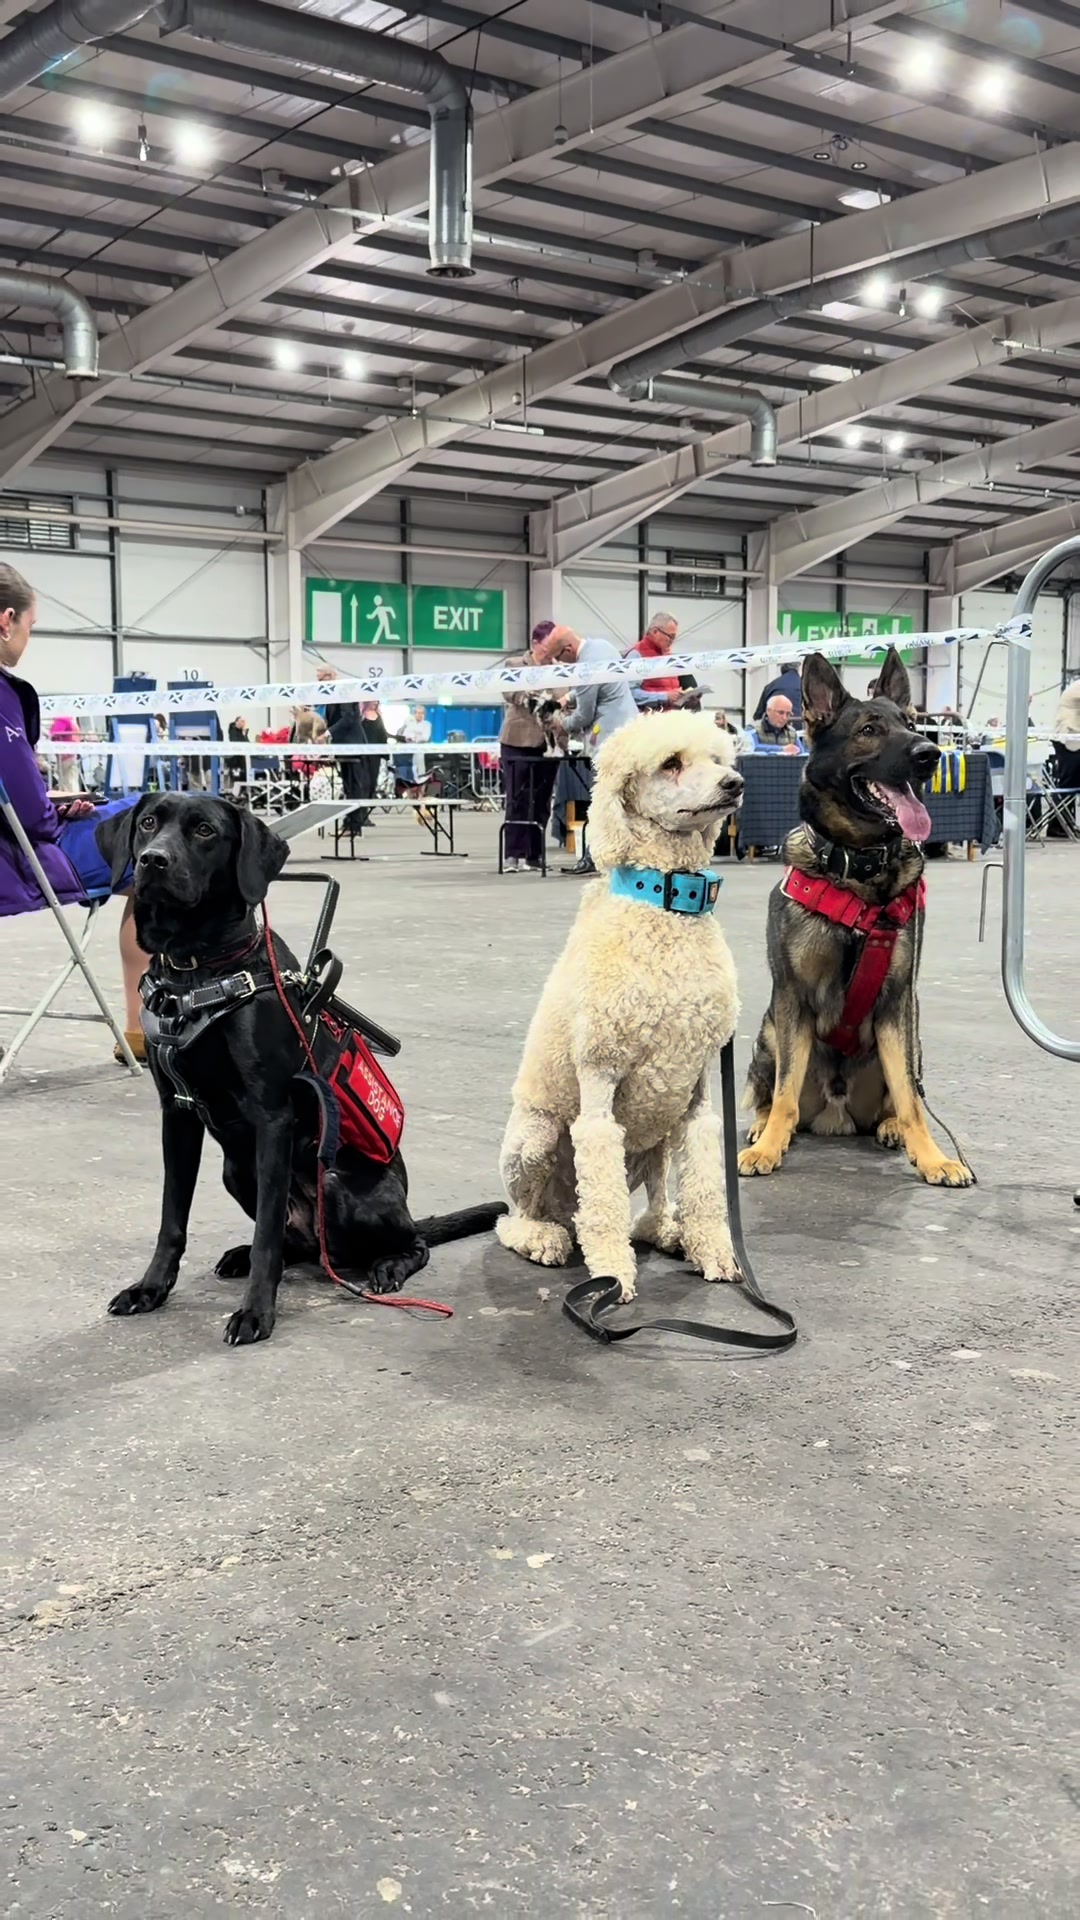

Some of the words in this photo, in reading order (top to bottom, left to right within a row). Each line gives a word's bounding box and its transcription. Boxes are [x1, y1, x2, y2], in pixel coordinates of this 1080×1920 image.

[433, 605, 484, 632] EXIT
[183, 669, 200, 682] 10
[368, 666, 384, 679] S2
[367, 1090, 386, 1121] DOG
